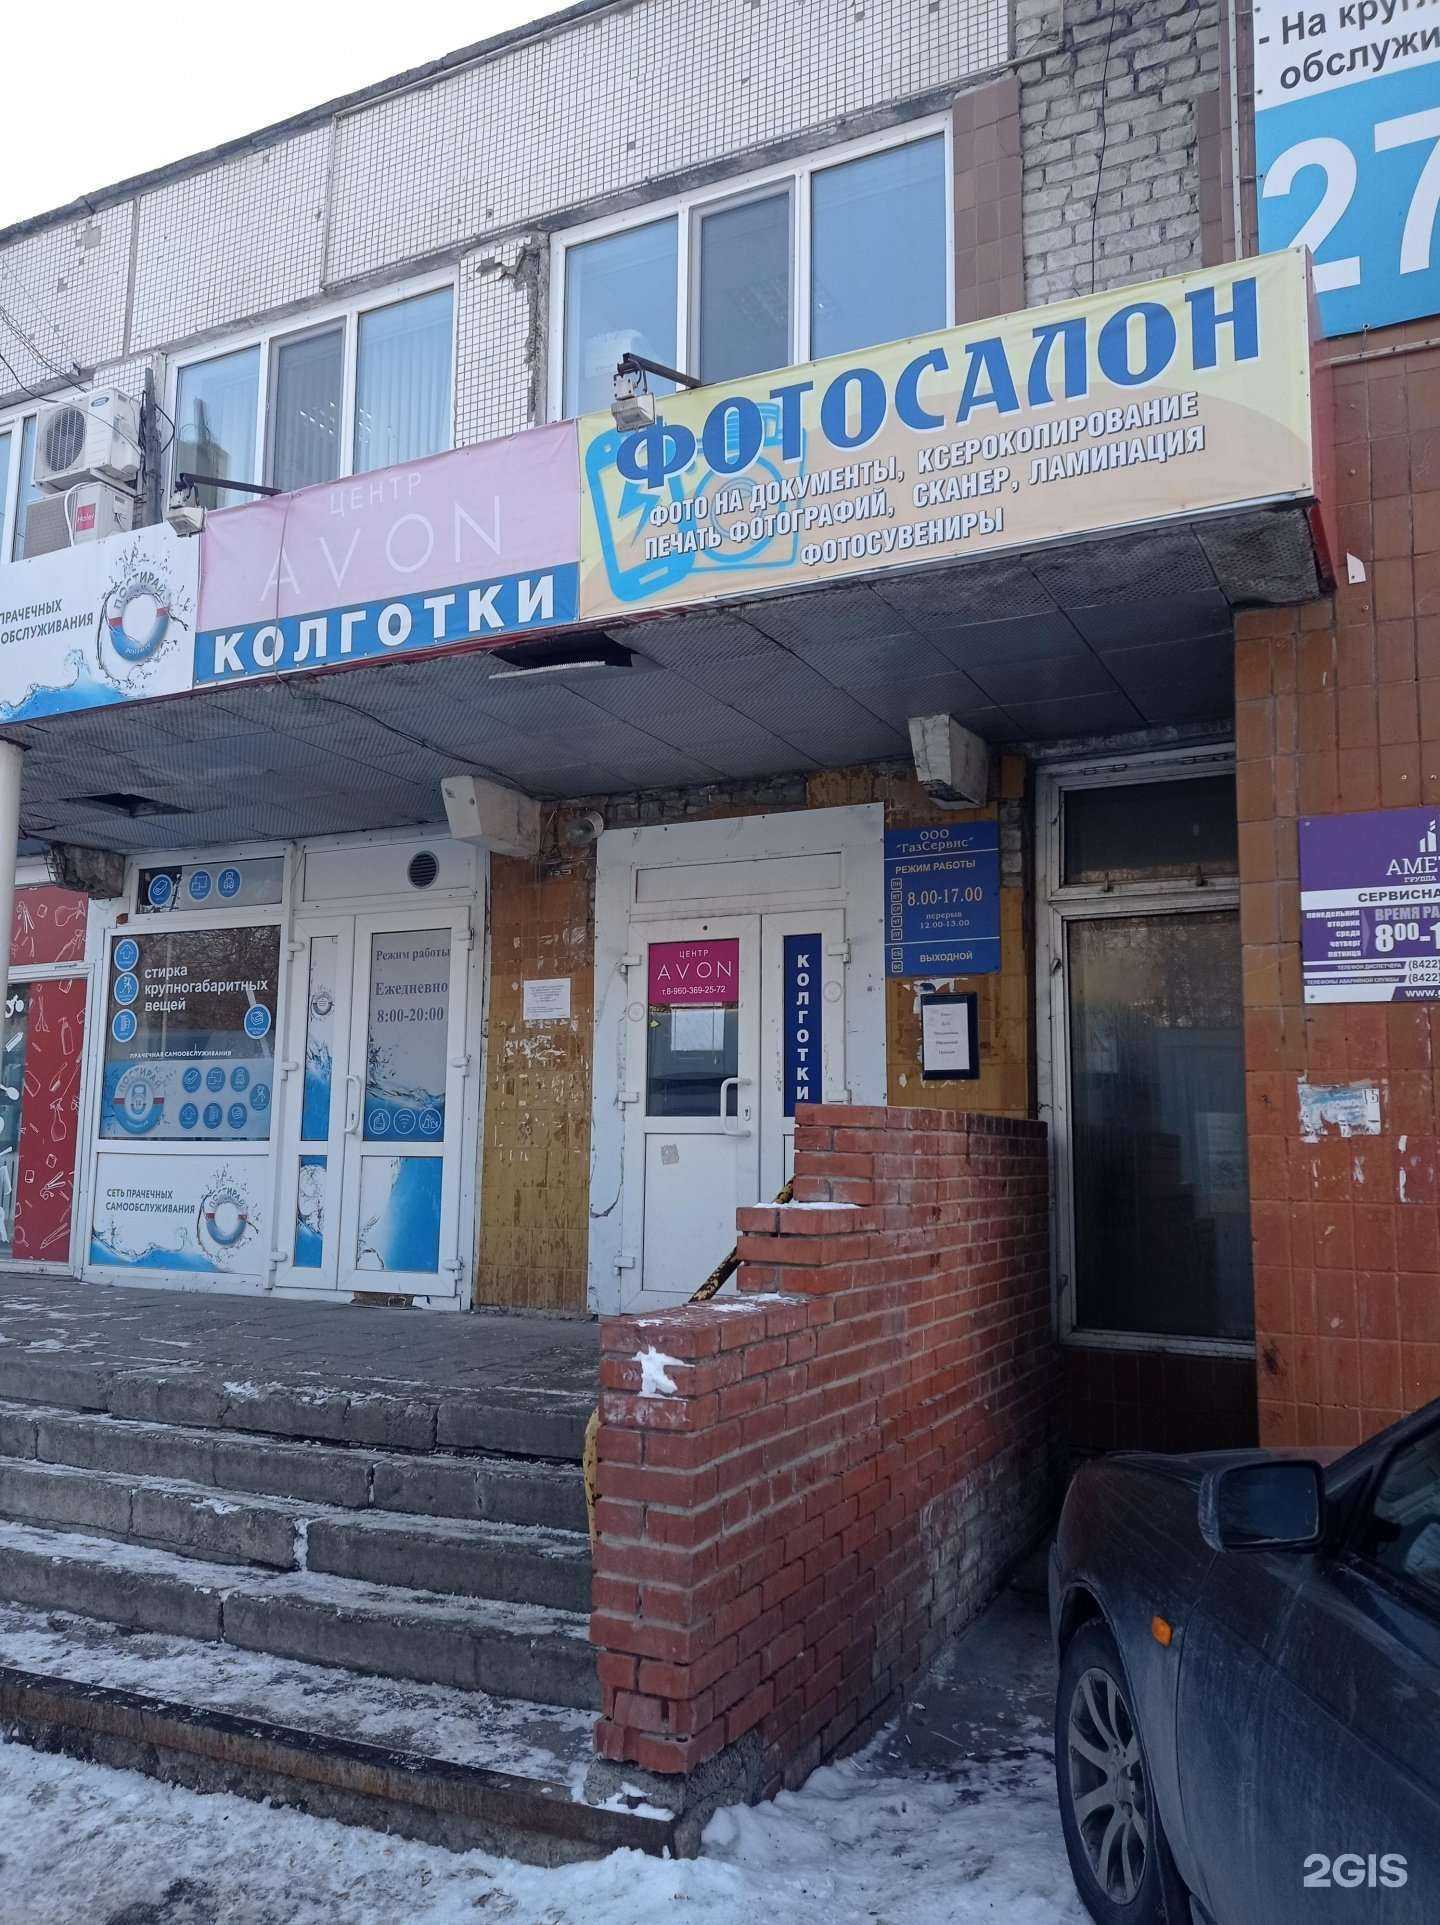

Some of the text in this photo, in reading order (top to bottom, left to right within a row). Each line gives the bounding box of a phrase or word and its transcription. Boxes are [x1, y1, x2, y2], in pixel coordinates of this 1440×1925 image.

[1281, 10, 1327, 45] На
[1338, 0, 1440, 31] кру
[1280, 26, 1440, 90] обслужи
[615, 276, 1260, 490] ФОТОСАЛОН
[649, 391, 1200, 528] ФОТО НА ДОКУМЕНТЫ, КСЕРОКОПИРОВАНИЕ
[329, 471, 423, 517] ЦЕНТР
[644, 425, 1206, 561] ПЕЧАТЬ ФОТОГРАФИЙ, СКАНЕР, ЛАМИНАЦИЯ
[800, 507, 1004, 567] ФОТОСУВЕНИРЫ
[259, 495, 504, 602] AVON
[0, 612, 94, 645] ОБСЛУЖИВАНИЯ
[213, 574, 555, 675] КОЛГОТКИ
[919, 829, 950, 841] ООО
[895, 860, 976, 875] РЕЖИМ РАБОТЫ
[1385, 856, 1440, 876] АМЕ
[907, 886, 983, 907] 8.00-17.00
[1375, 906, 1420, 921] ВРЕМЯ
[375, 948, 450, 962] Режим работы
[679, 949, 709, 959] ЦЕНТР
[920, 950, 974, 963] ВЫХОДНОЙ
[144, 965, 188, 979] стирка
[657, 961, 732, 981] AVON
[144, 979, 268, 997] крупногабаритных
[375, 982, 448, 996] Ежедневно
[144, 997, 186, 1013] вещей
[377, 1006, 444, 1022] 8:00-20:00
[796, 954, 811, 1101] КОЛГОТКИ
[106, 1188, 174, 1200] СЕТЬ ПРАЧЕЧНЫХ
[105, 1202, 196, 1214] САМООБСЛУЖИВАНИЯ
